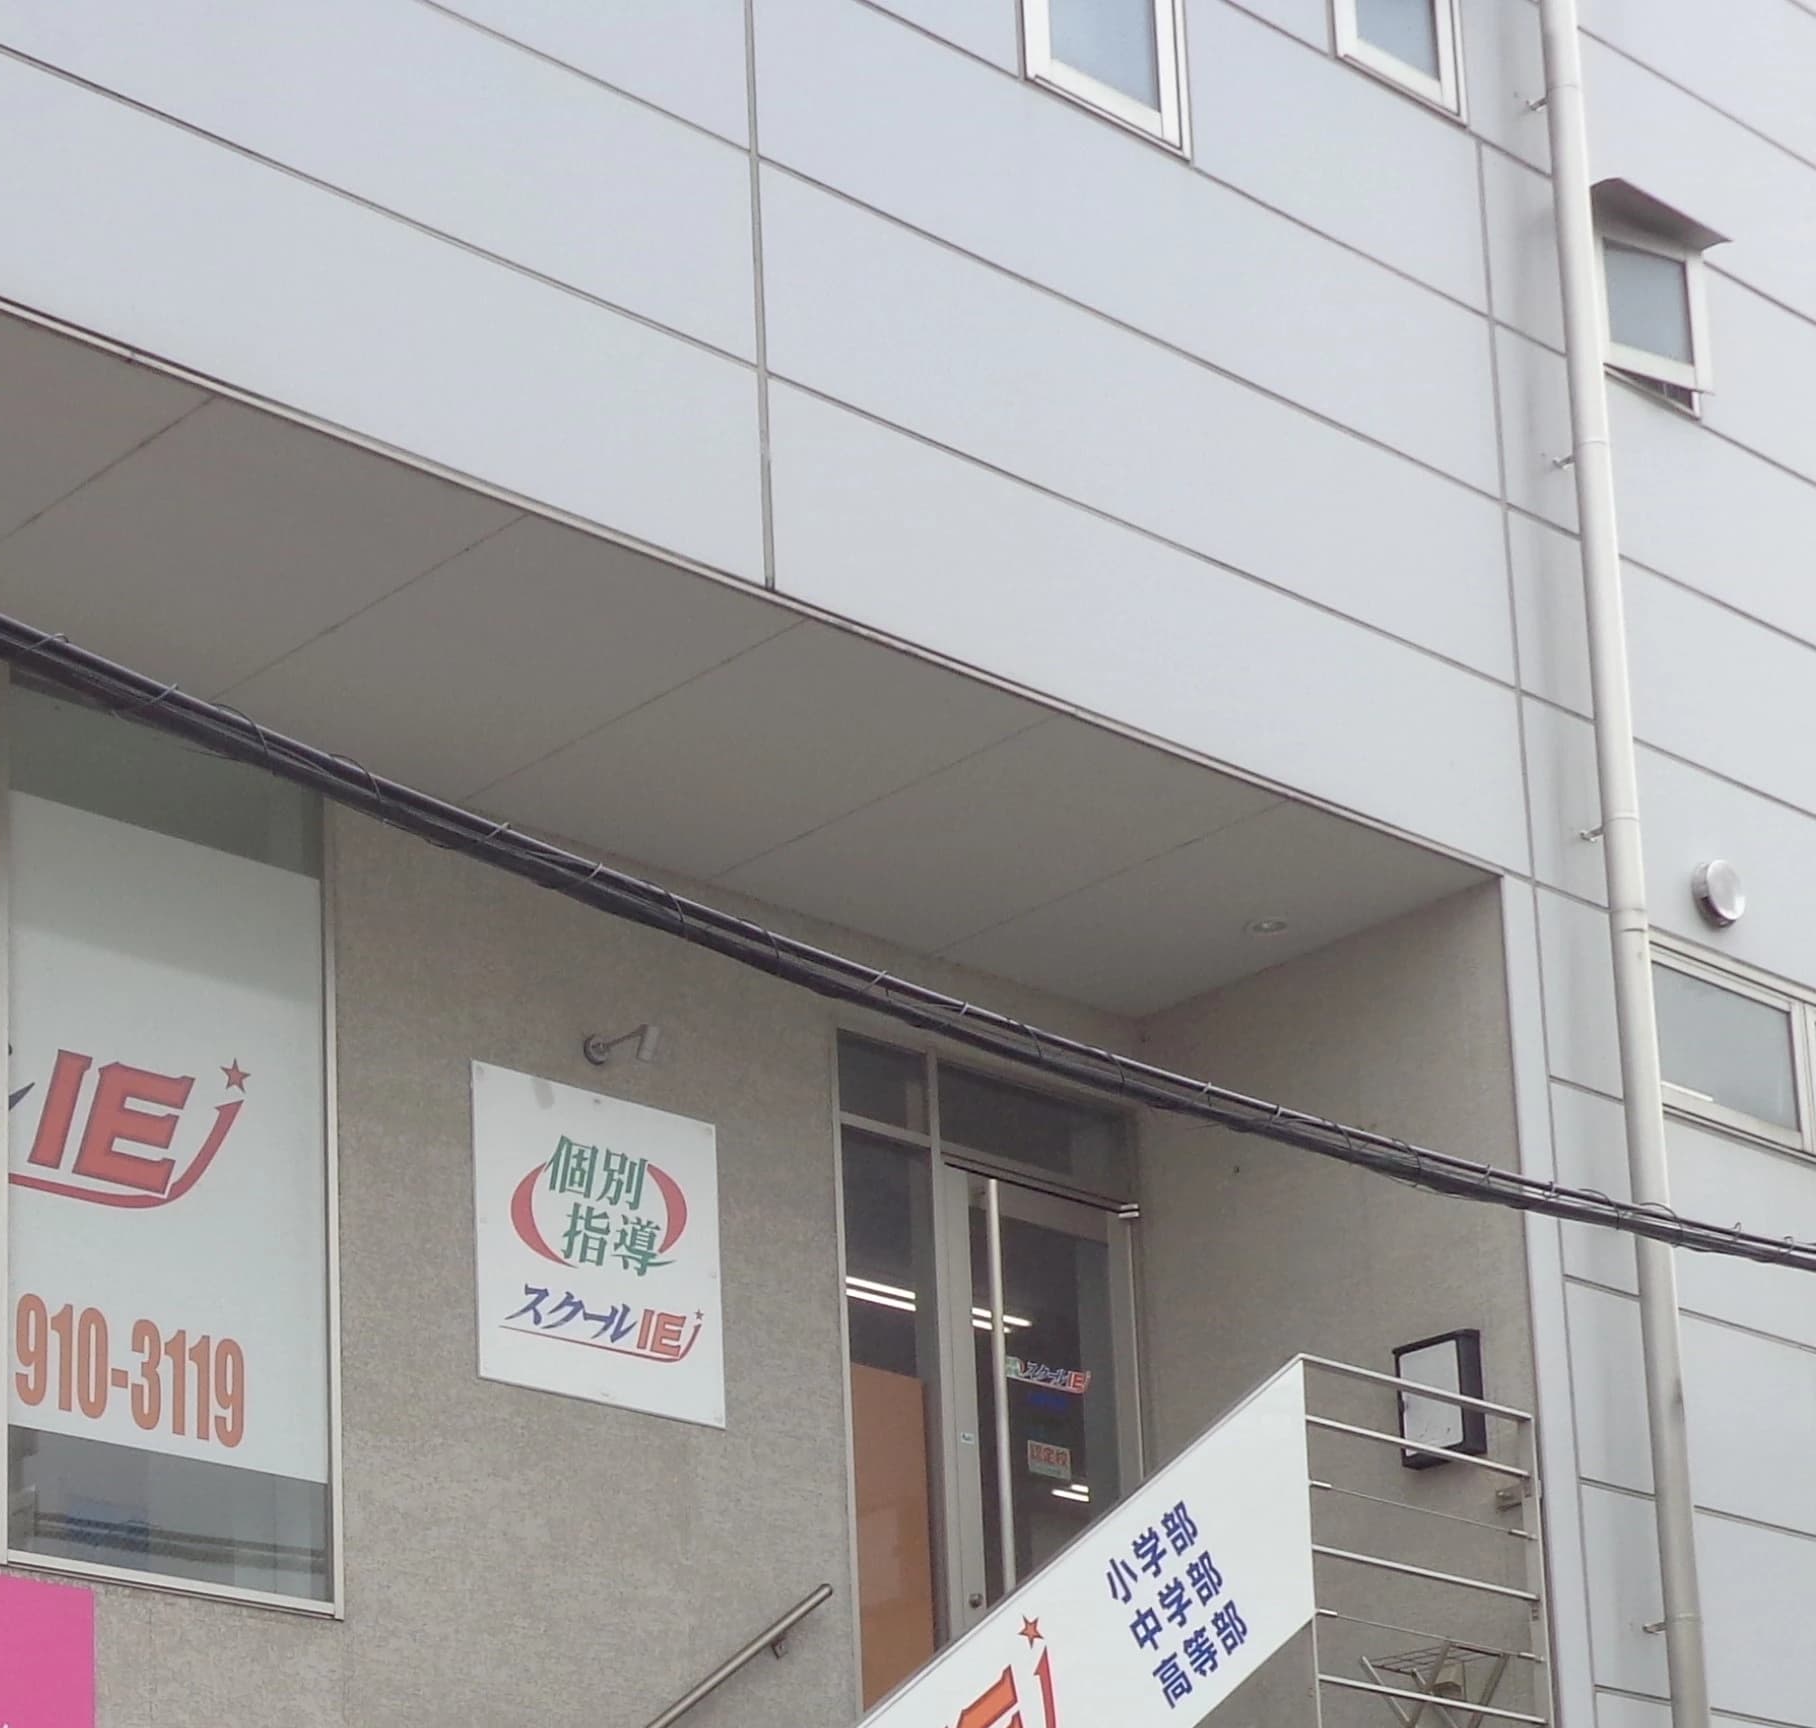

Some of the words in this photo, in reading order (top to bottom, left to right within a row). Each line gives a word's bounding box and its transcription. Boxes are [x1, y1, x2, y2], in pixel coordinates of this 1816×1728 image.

[545, 1135, 648, 1209] 個別
[562, 1206, 676, 1276] 指導
[1105, 1502, 1200, 1603] 小学部
[1129, 1555, 1225, 1654] 中学部
[1152, 1602, 1250, 1709] 高等部
